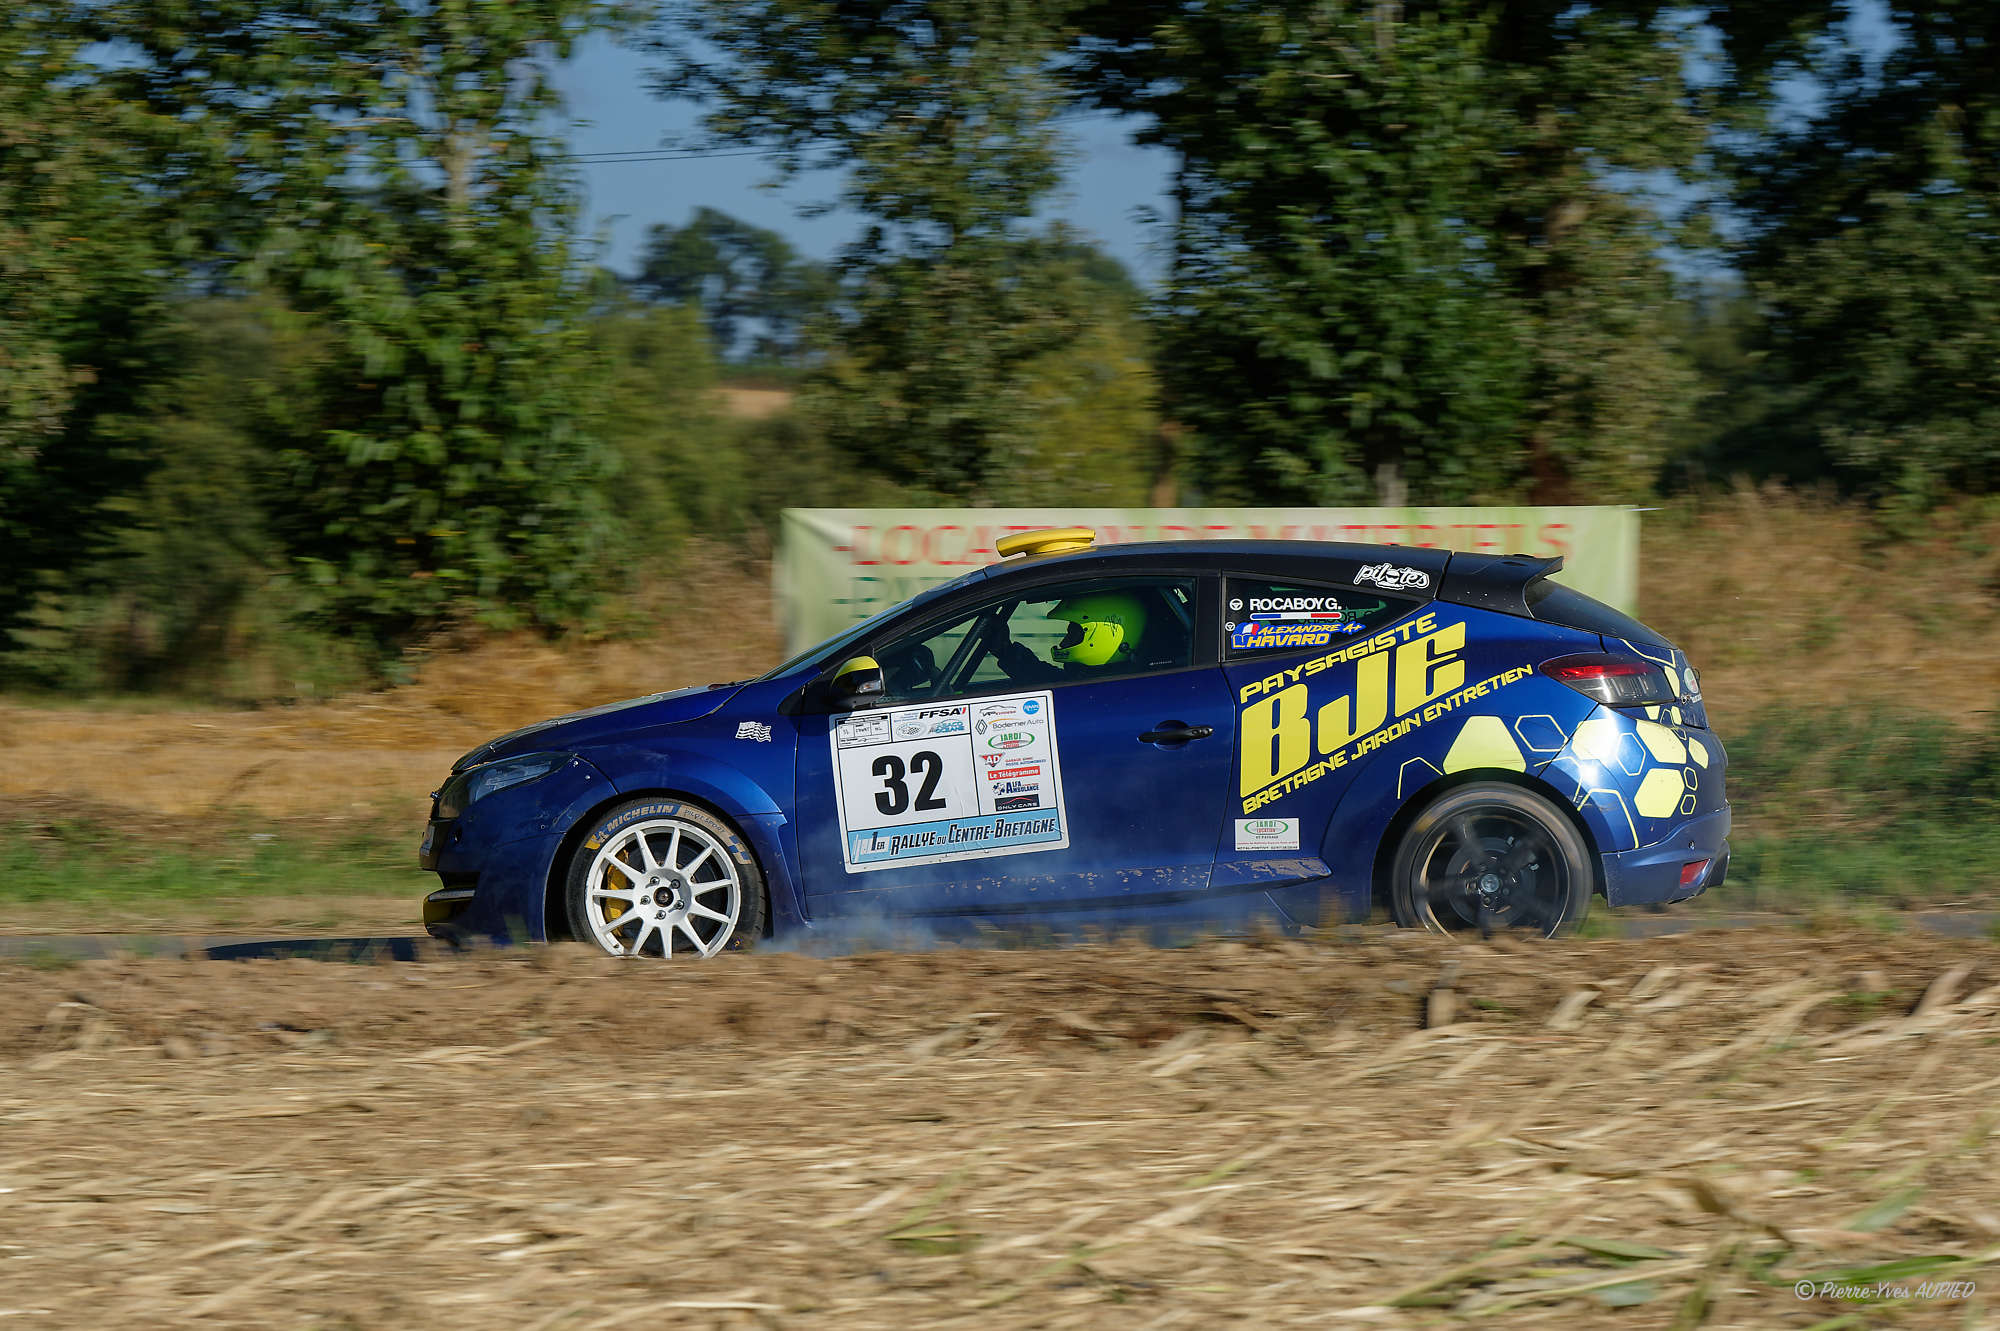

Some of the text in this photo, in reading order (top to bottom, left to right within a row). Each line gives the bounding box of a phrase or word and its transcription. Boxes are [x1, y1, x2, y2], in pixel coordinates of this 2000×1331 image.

[1354, 563, 1429, 589] pilotes
[1250, 598, 1342, 611] ROCABOY G.
[1246, 634, 1330, 648] HAVARD
[1258, 623, 1363, 635] ALEXANDRE A+
[1240, 612, 1437, 703] PAYSAGISTE
[919, 707, 961, 719] FFSA
[1240, 621, 1466, 798] BJE
[1242, 664, 1533, 815] BRETAGNE JARDIN ENTRETIEN
[986, 755, 1000, 763] AD
[872, 751, 947, 816] 32
[1000, 768, 1039, 778] Télégramme
[607, 805, 674, 832] MICHELIN
[704, 817, 726, 833] SPORT
[889, 831, 937, 855] RALLYE
[948, 818, 1056, 844] CENTRE-BRETAGNE
